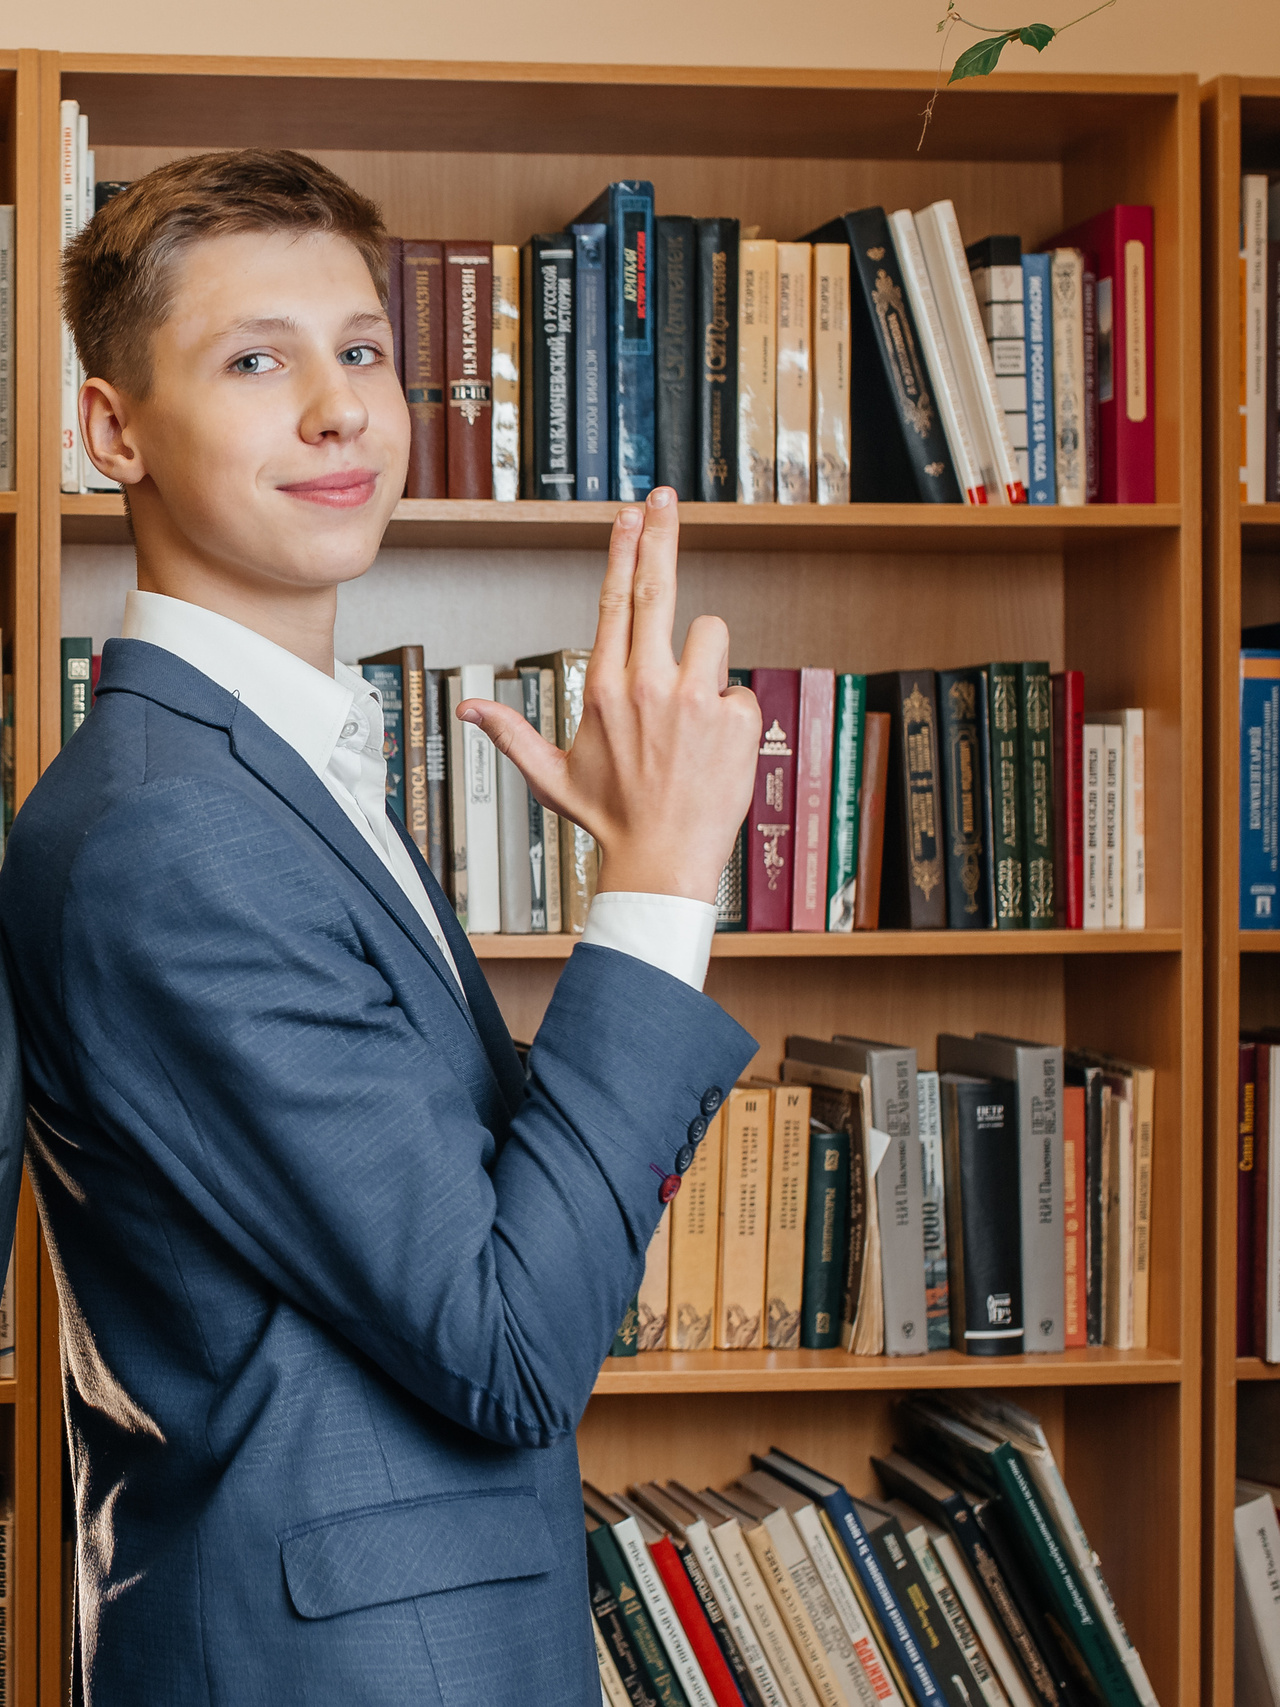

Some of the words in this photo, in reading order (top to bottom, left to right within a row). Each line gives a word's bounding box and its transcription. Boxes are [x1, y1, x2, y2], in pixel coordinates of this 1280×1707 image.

[542, 265, 557, 320] РУССКОЙ
[623, 247, 637, 302] КРАТКАЯ
[558, 278, 571, 333] ИСТОРИИ
[1030, 276, 1043, 342] ИСТОРИЯ
[586, 350, 597, 403] ИСТОРИЯ
[1031, 344, 1044, 401] РОССИИ
[586, 407, 597, 454] РОССИИ
[1034, 443, 1047, 481] ЧАСА
[409, 670, 423, 748] ИСТОРИИ
[411, 765, 426, 831] ГОЛОСА
[745, 1102, 756, 1111] III
[787, 1095, 800, 1106] IV
[852, 1636, 893, 1701] АВАНГАРД
